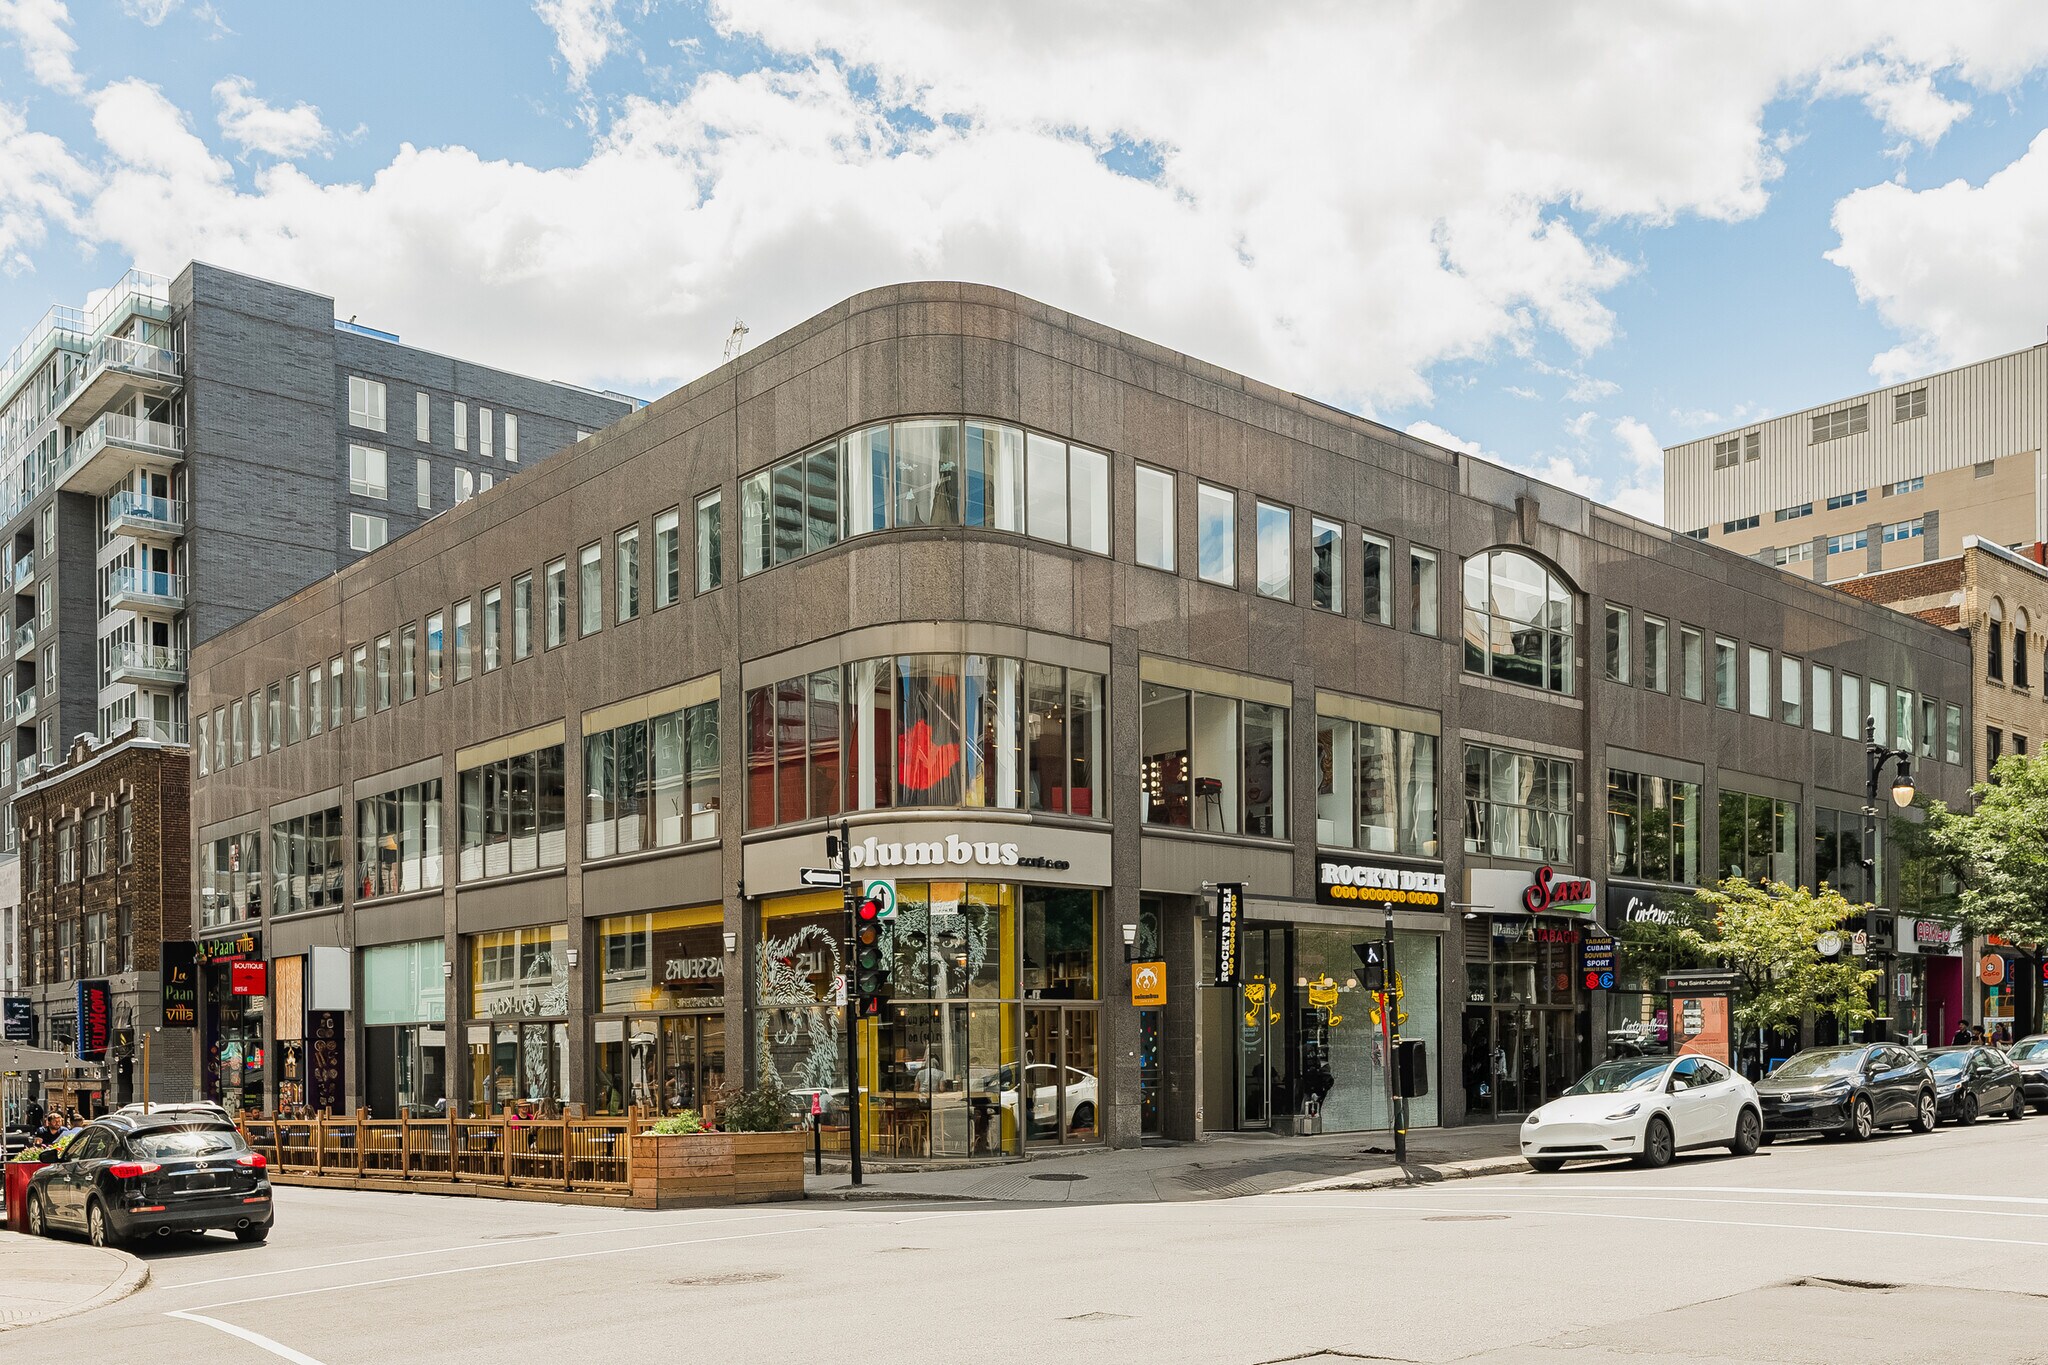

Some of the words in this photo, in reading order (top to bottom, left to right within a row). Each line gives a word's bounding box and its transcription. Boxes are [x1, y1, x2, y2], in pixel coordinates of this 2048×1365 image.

[1321, 863, 1399, 889] ROCK'N
[1399, 870, 1446, 893] DELI
[1334, 886, 1358, 899] MTL
[1361, 888, 1406, 902] SMOKED
[1409, 892, 1439, 905] MEAT
[1223, 888, 1232, 923] DELI
[214, 940, 234, 956] Paan
[1221, 926, 1230, 982] ROCK'N
[172, 966, 188, 983] La
[166, 985, 194, 1000] Paan
[166, 1004, 194, 1020] villa
